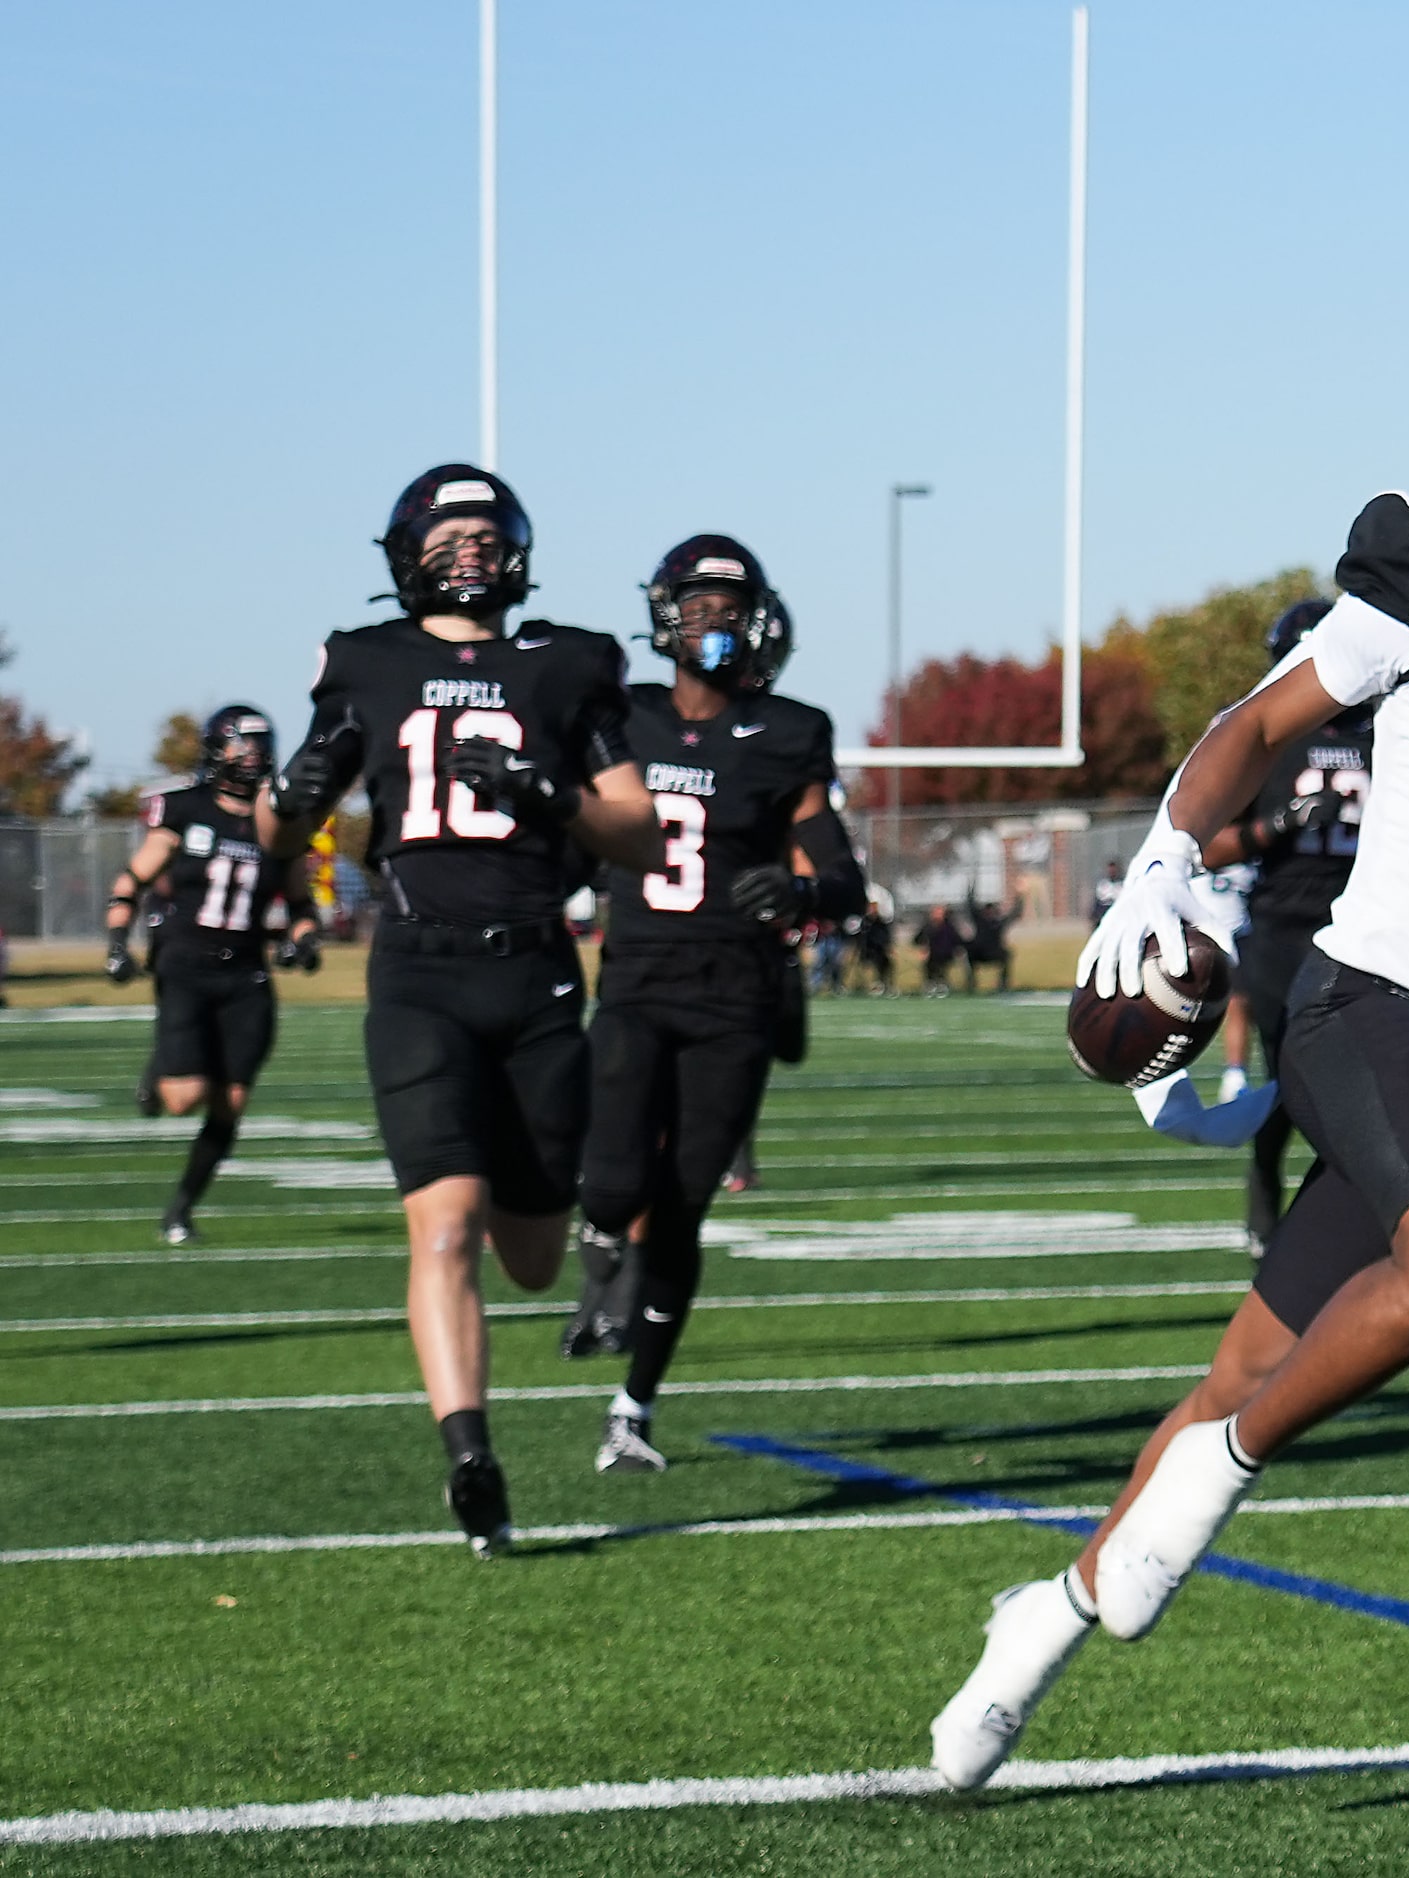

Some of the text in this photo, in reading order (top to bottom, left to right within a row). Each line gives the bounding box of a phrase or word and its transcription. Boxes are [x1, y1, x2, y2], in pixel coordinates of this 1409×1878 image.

[422, 678, 506, 708] COPPELL
[643, 792, 707, 912] 3
[196, 855, 260, 932] 11
